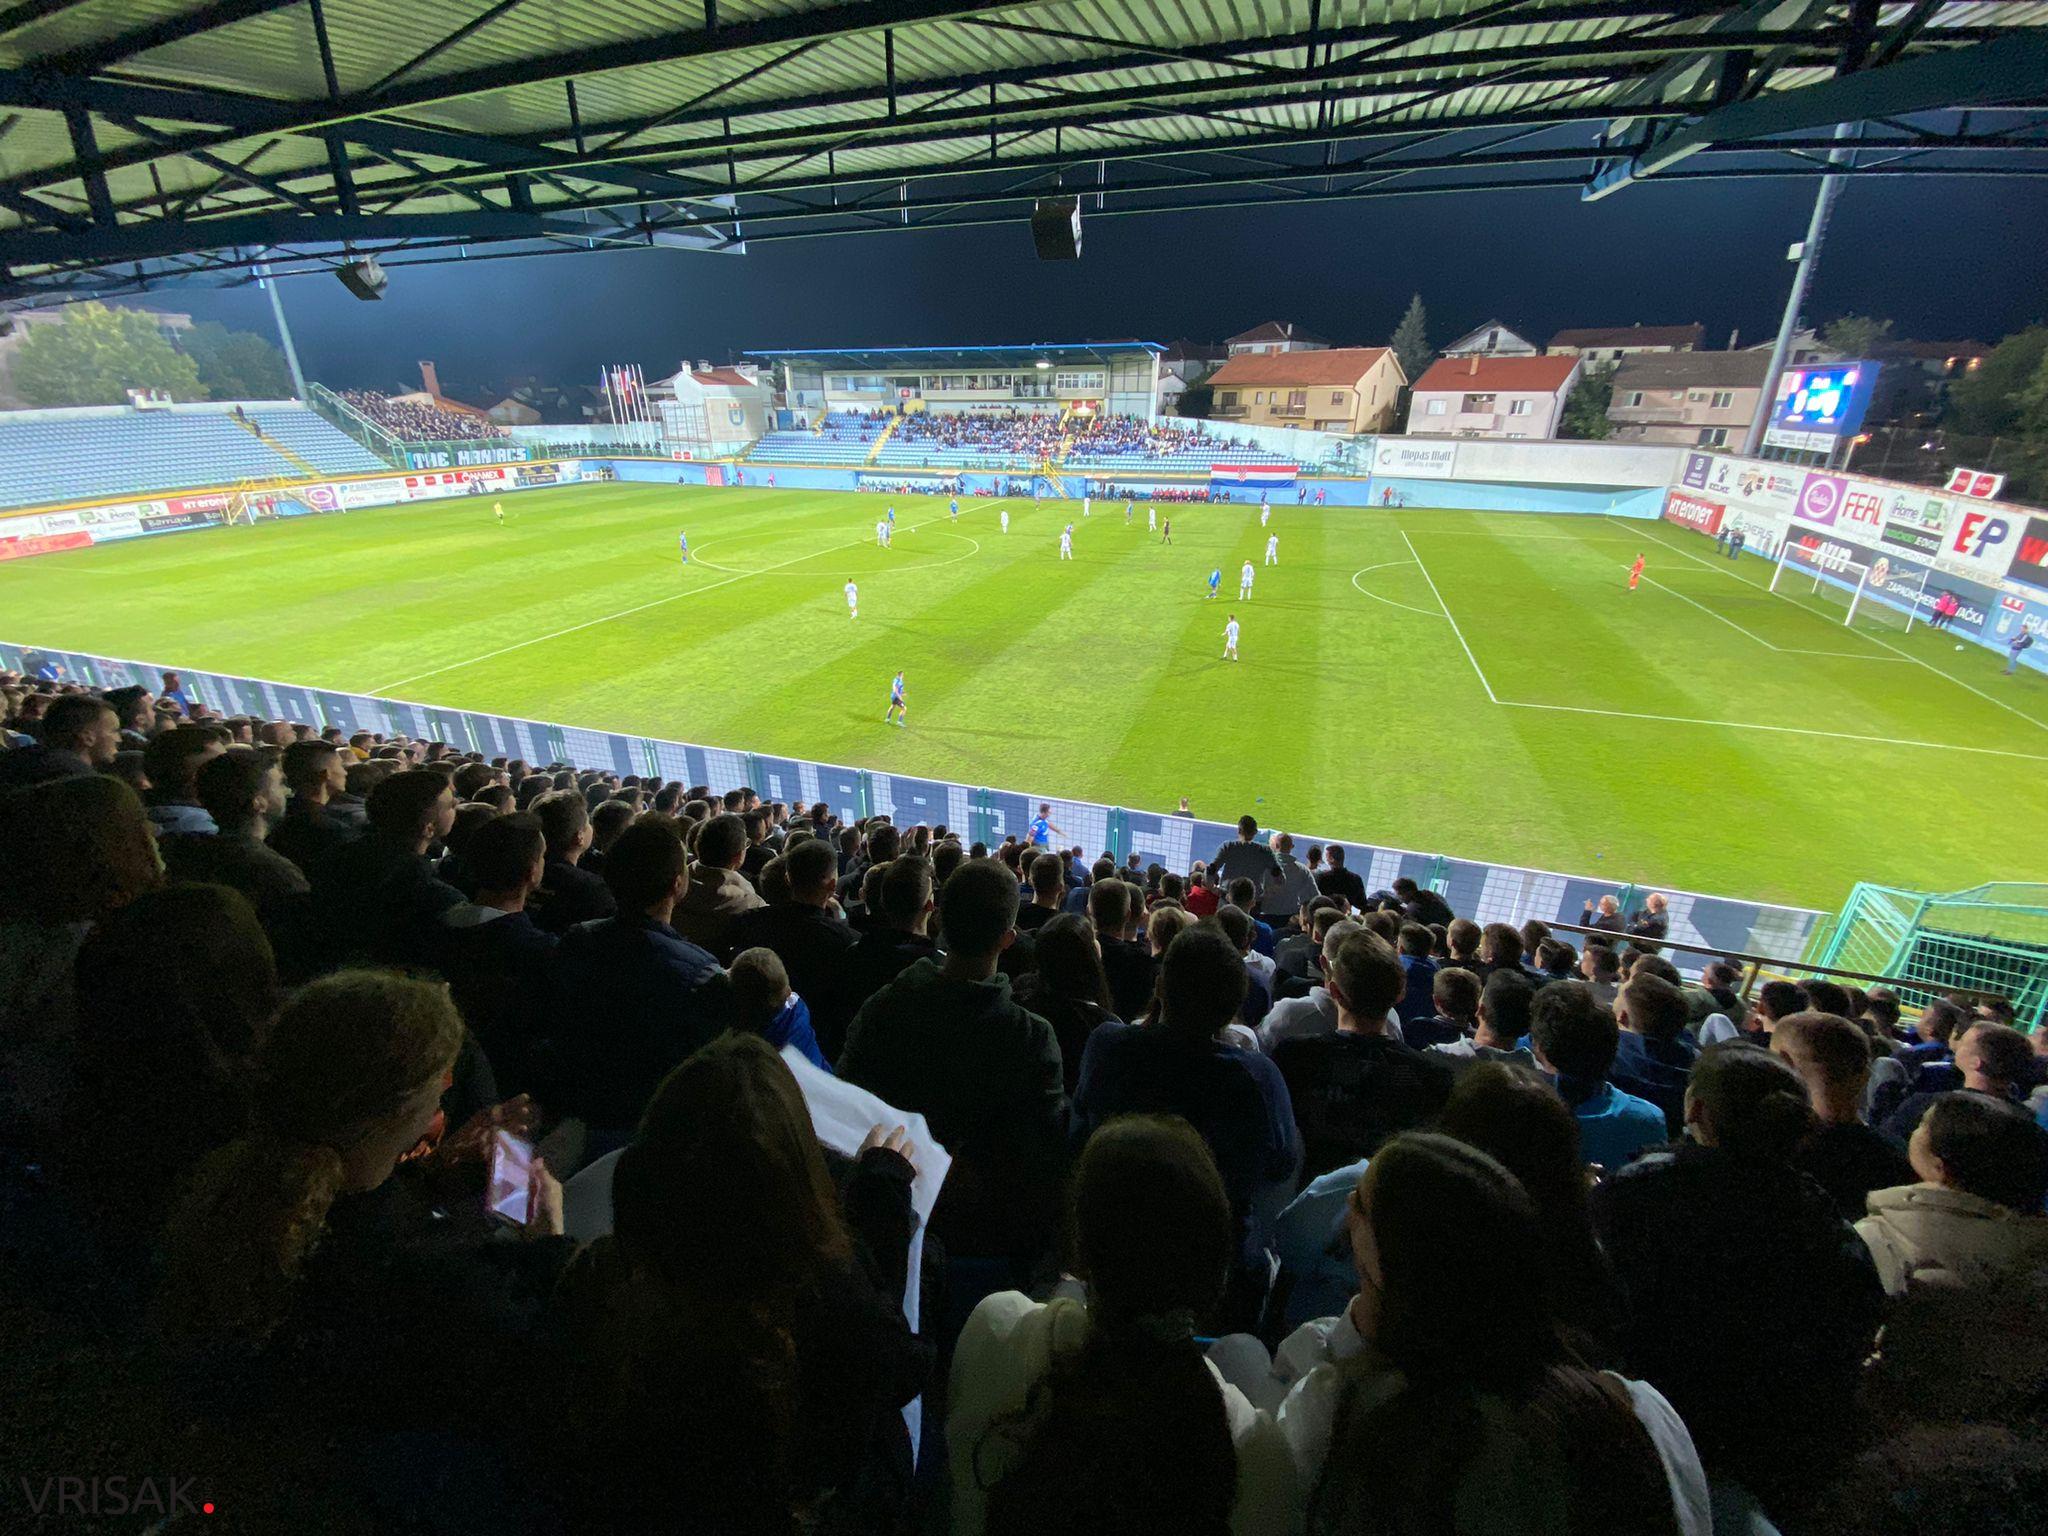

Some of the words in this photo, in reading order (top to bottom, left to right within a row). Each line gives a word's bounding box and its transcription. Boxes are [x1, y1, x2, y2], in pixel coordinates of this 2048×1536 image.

[413, 451, 450, 469] THE
[456, 447, 527, 466] MANIACS
[1842, 492, 1885, 526] FEAL
[1953, 512, 2009, 558] EP
